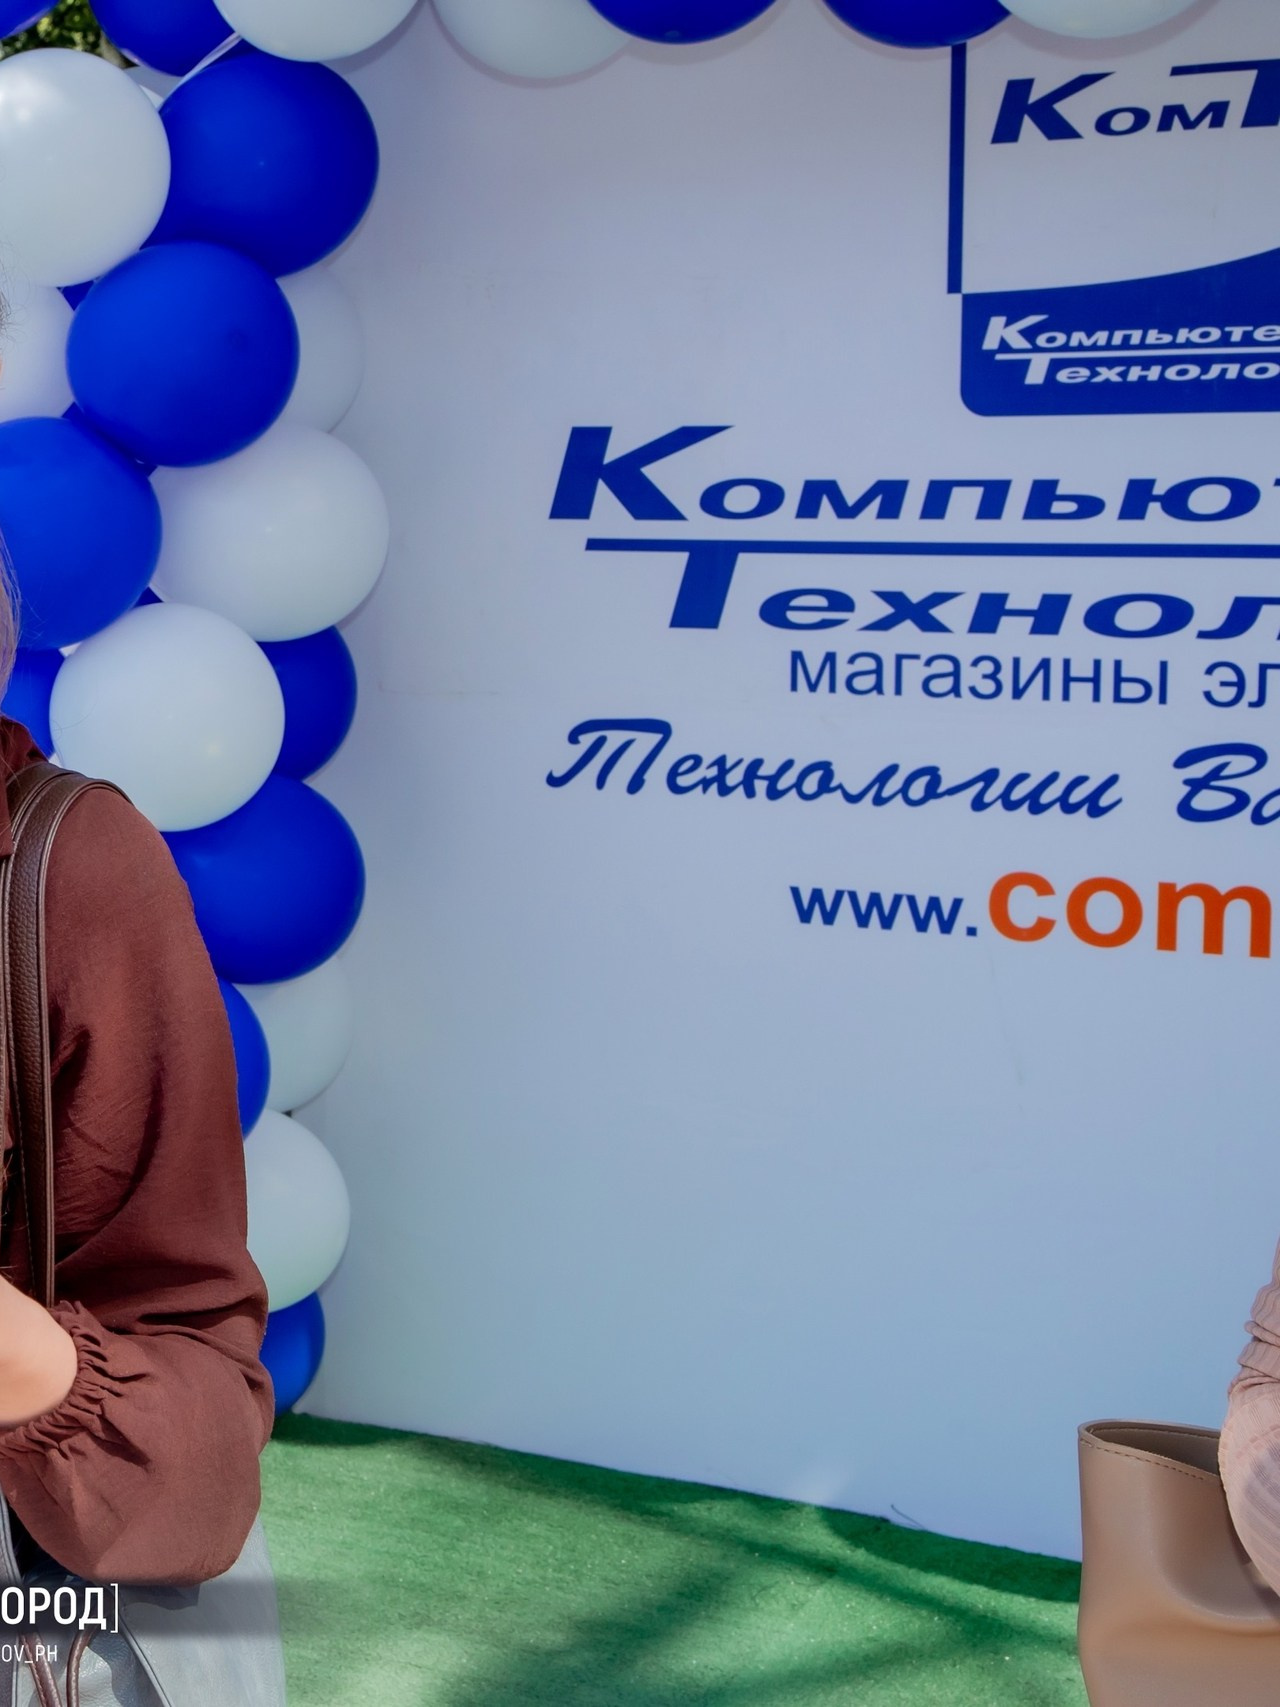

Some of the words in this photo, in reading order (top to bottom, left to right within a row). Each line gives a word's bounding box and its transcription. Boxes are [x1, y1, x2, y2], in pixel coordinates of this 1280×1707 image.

[548, 425, 1280, 522] Компью
[790, 651, 1169, 706] магазины
[546, 718, 1123, 819] Технологии
